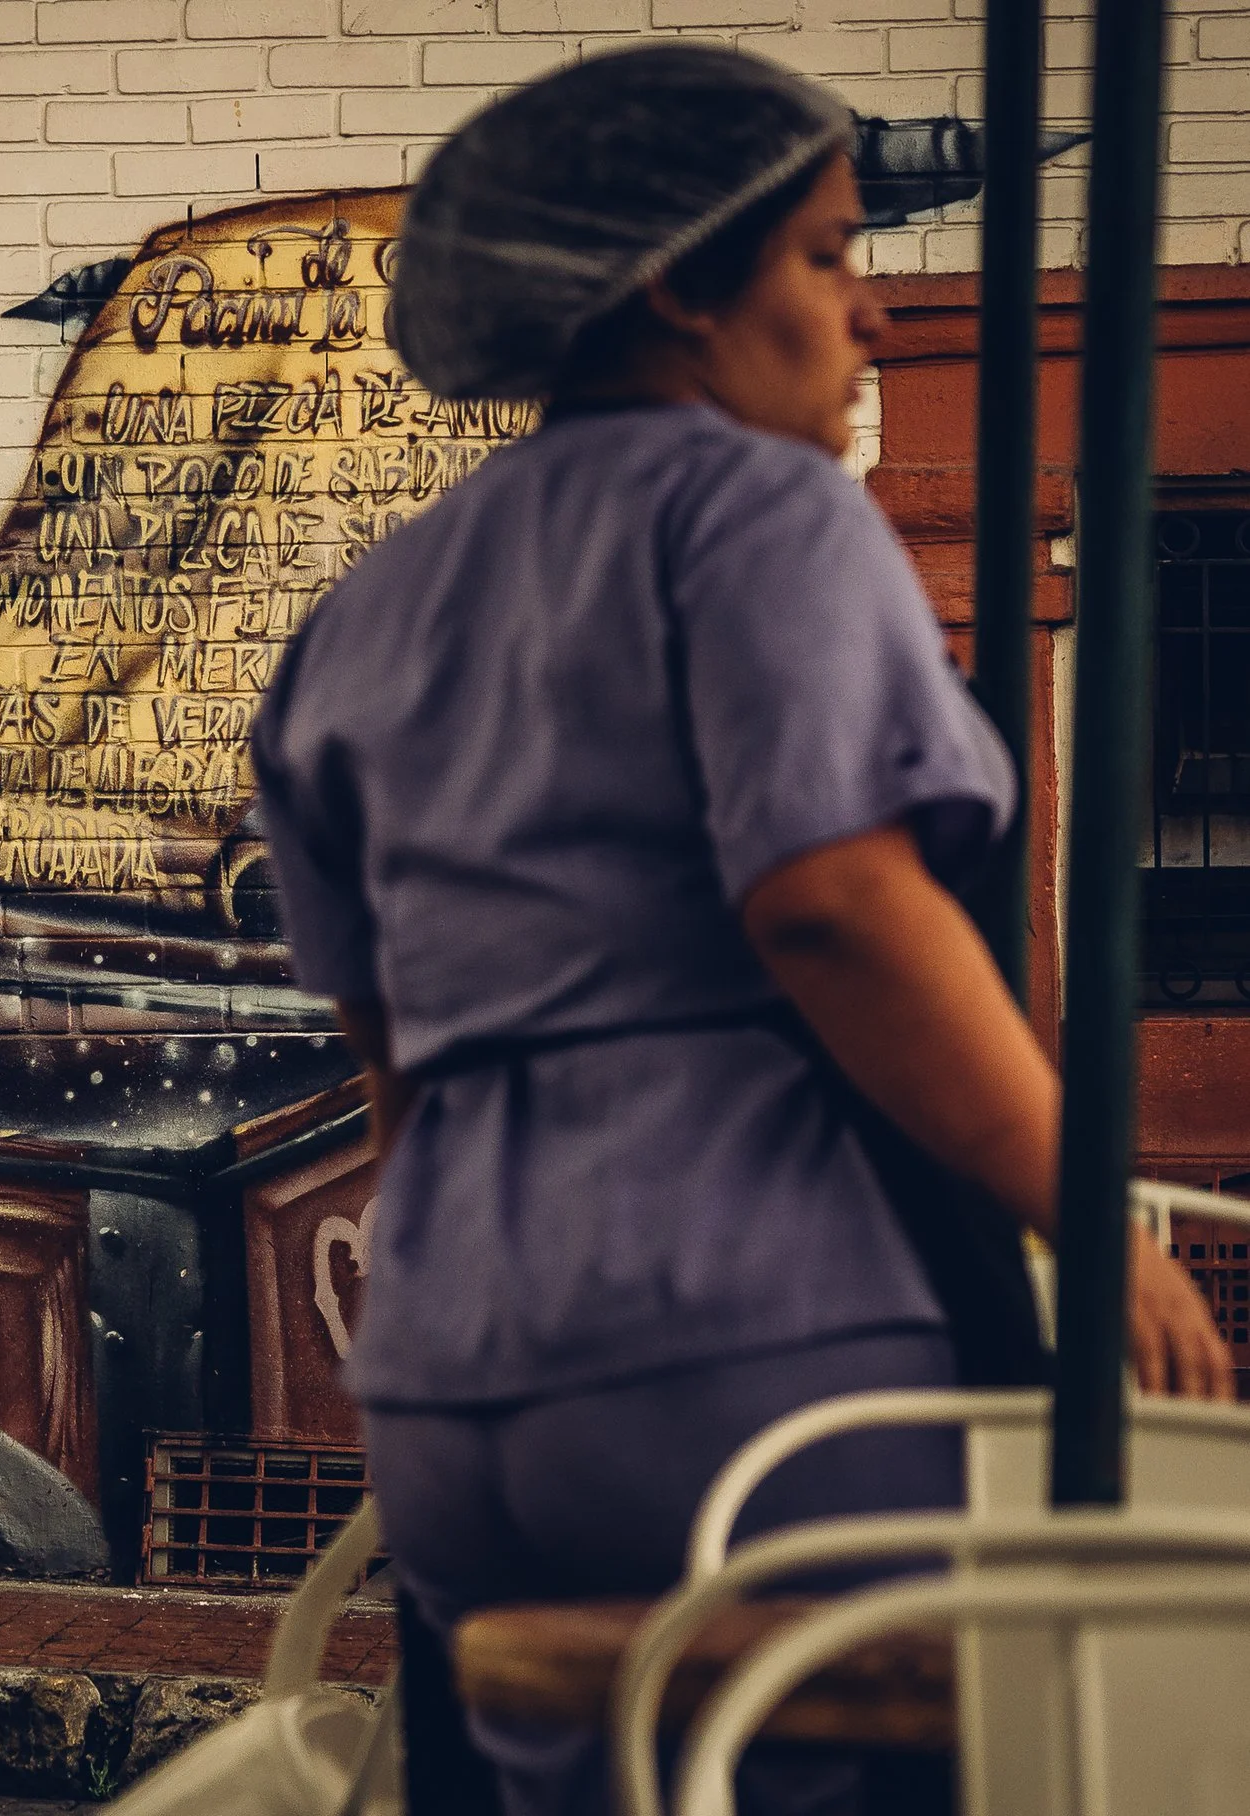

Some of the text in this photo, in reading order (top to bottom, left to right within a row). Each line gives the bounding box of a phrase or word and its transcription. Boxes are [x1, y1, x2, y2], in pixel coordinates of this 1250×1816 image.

[102, 366, 532, 444] UNA PIZCA DE AMO
[60, 452, 130, 512] UN
[136, 450, 266, 503] POCO
[274, 451, 314, 504] DE
[37, 506, 121, 568] UNA
[130, 504, 270, 580] PIZCA
[277, 508, 324, 568] DE
[43, 633, 120, 684] EN
[85, 691, 130, 747] DE
[152, 694, 254, 753] VERD
[47, 748, 89, 805] DE
